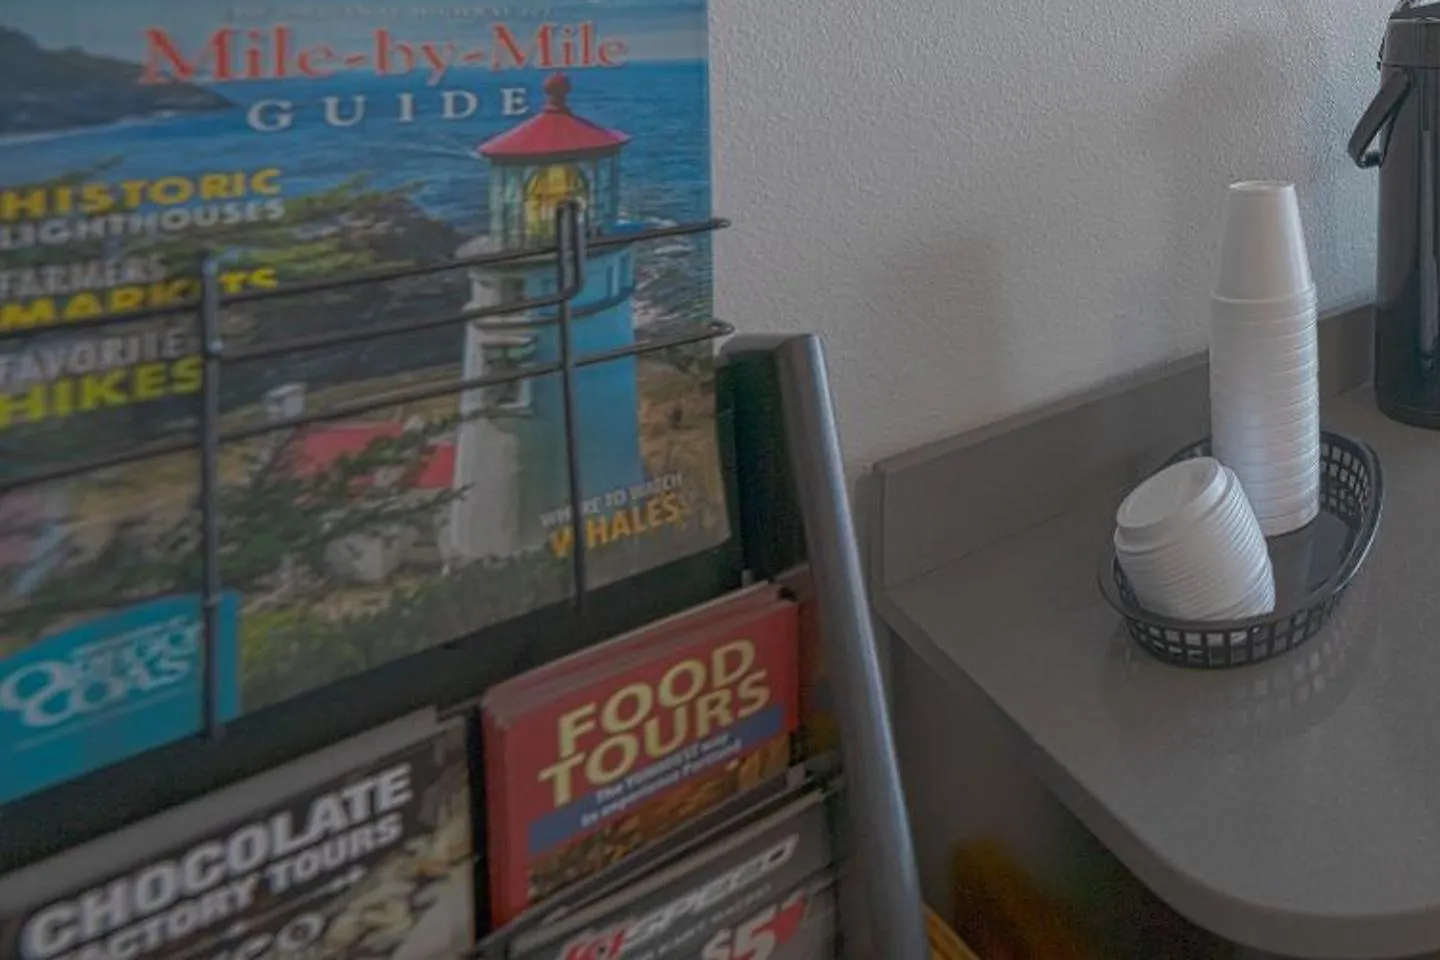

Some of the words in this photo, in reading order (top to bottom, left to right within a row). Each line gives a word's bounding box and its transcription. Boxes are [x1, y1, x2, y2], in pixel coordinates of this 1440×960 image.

[138, 19, 631, 87] Mile-by-Mile
[245, 86, 531, 133] GUIDE
[0, 167, 282, 221] HISTORIC
[0, 197, 287, 250] LIGHTHOUSES
[0, 355, 204, 429] HIKES
[557, 639, 756, 758] FOOD
[536, 668, 771, 808] TOURS
[19, 762, 414, 960] CHOCOLATE
[267, 813, 405, 894] TOURS
